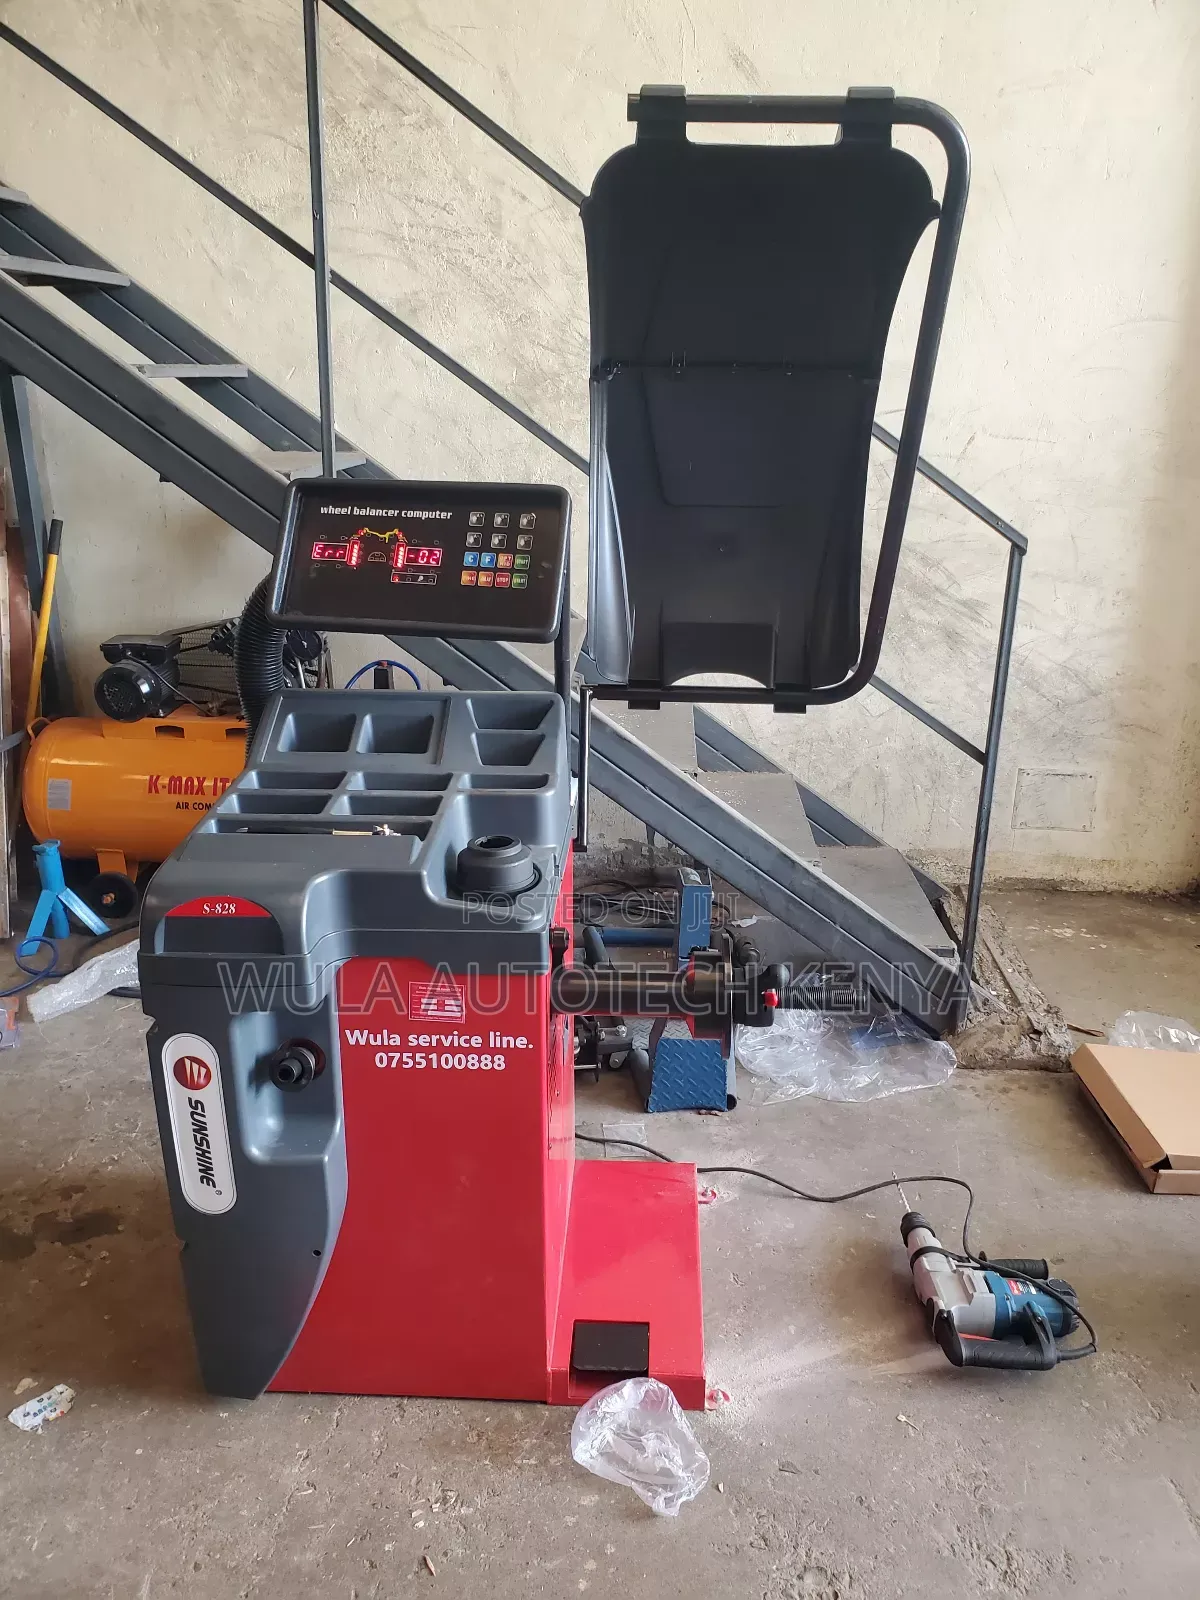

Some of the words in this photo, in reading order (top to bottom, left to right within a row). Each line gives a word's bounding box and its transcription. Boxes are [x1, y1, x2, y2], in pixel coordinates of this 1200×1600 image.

[320, 505, 352, 516] wheel
[353, 506, 400, 518] balancer
[401, 509, 453, 520] computer
[313, 544, 345, 558] Err
[148, 774, 206, 796] K-MAX
[212, 776, 235, 797] IT
[176, 801, 190, 811] AIR
[202, 902, 237, 915] S-828
[345, 1029, 401, 1046] Wula
[408, 1031, 483, 1048] service
[489, 1031, 534, 1049] line.
[375, 1052, 506, 1071] 0755100888
[187, 1096, 217, 1189] SUNSHINE
